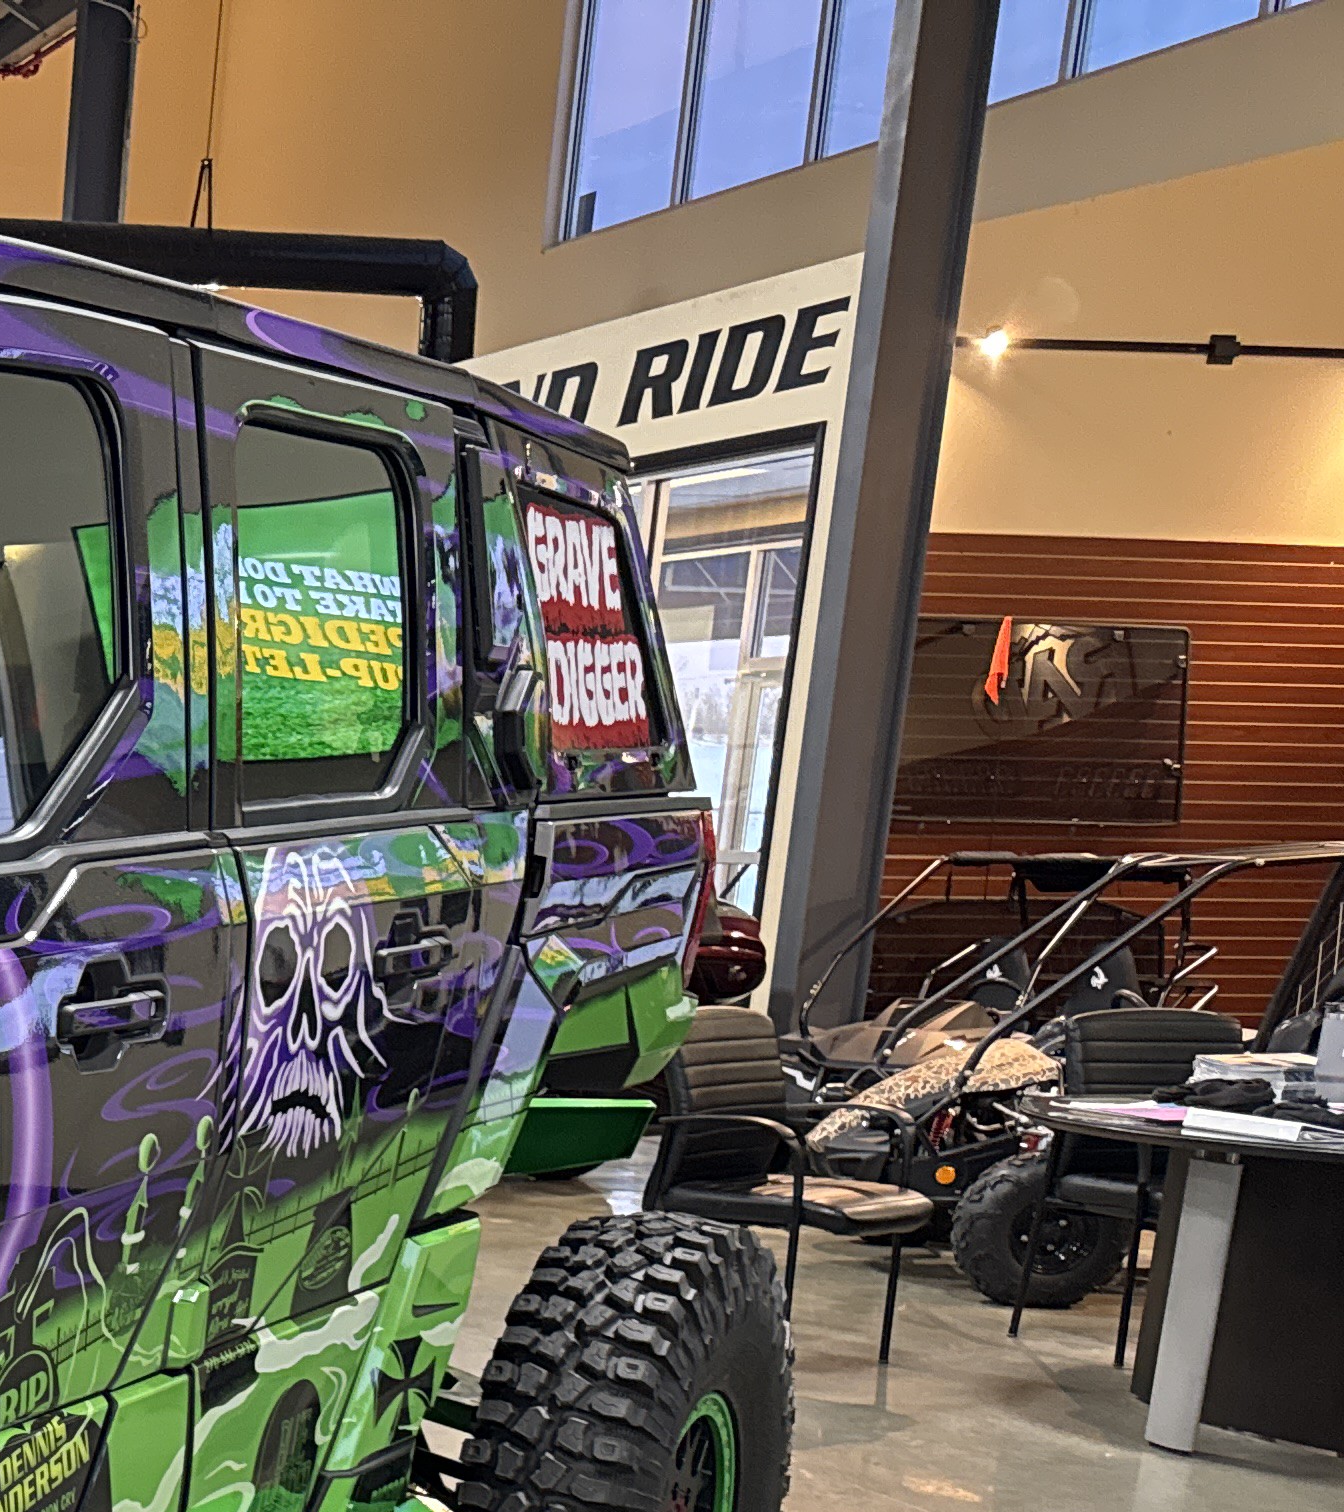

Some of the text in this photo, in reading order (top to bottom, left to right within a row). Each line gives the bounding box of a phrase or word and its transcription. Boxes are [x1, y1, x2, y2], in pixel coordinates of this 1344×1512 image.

[616, 296, 852, 428] RIDE
[526, 505, 622, 611] GRAVE
[547, 638, 647, 728] DIGGER
